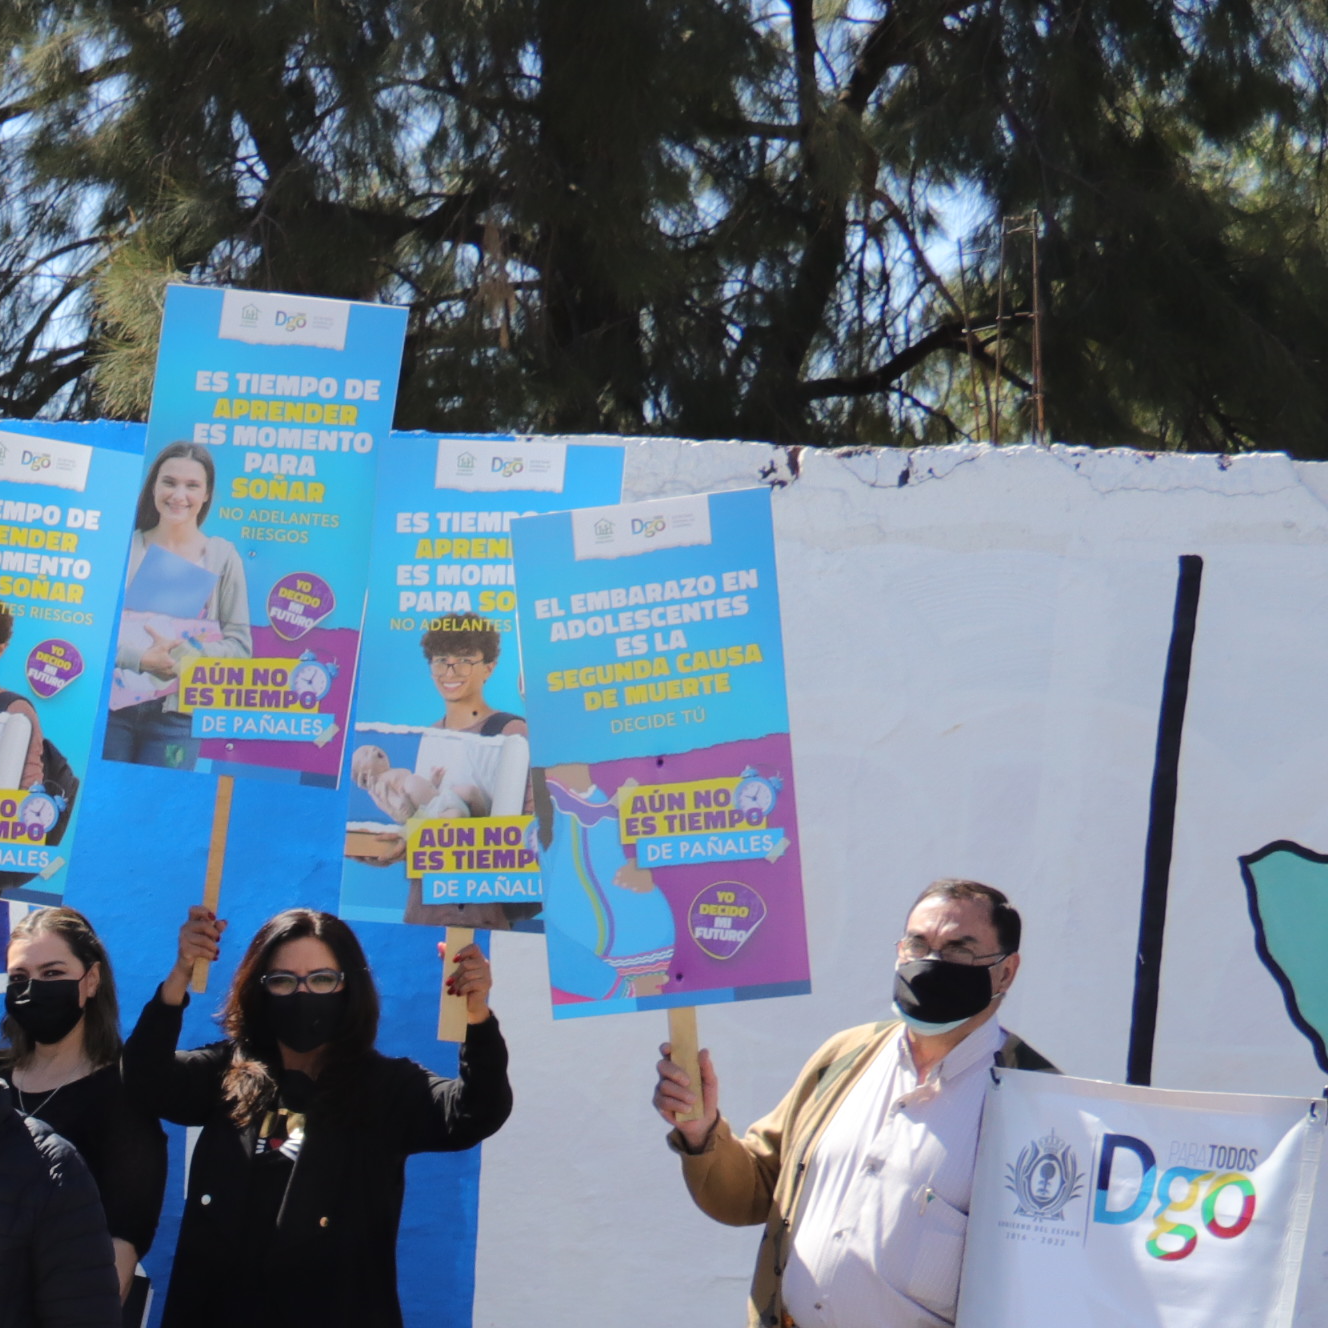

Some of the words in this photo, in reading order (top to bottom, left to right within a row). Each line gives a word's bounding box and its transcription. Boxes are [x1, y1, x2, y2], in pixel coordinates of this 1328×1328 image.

[230, 473, 326, 504] SOÑAR
[217, 505, 245, 521] NO
[247, 508, 340, 529] ADELANTES
[394, 513, 430, 533] ES
[436, 511, 541, 533] TIEM
[239, 526, 310, 544] RIESGOS
[415, 538, 513, 559] APREN
[190, 663, 245, 687] AÚN
[249, 667, 289, 689] NO
[546, 655, 670, 692] SEGUNDA
[675, 642, 763, 674] CAUSA
[583, 688, 618, 712] DE
[624, 672, 731, 706] MUERTE
[609, 712, 677, 735] DECIDE
[680, 705, 706, 725] TÚ
[418, 823, 476, 848] AÚN
[482, 827, 522, 848] NO
[646, 843, 673, 862] DE
[679, 833, 773, 859] PAÑALES
[410, 850, 446, 871] ES
[452, 848, 541, 869] TIEMP
[431, 879, 460, 898] DE
[466, 875, 543, 897] PAÑAL
[1169, 1140, 1205, 1166] PARA
[1208, 1144, 1258, 1172] TODOS
[1093, 1133, 1256, 1261] Dgo
